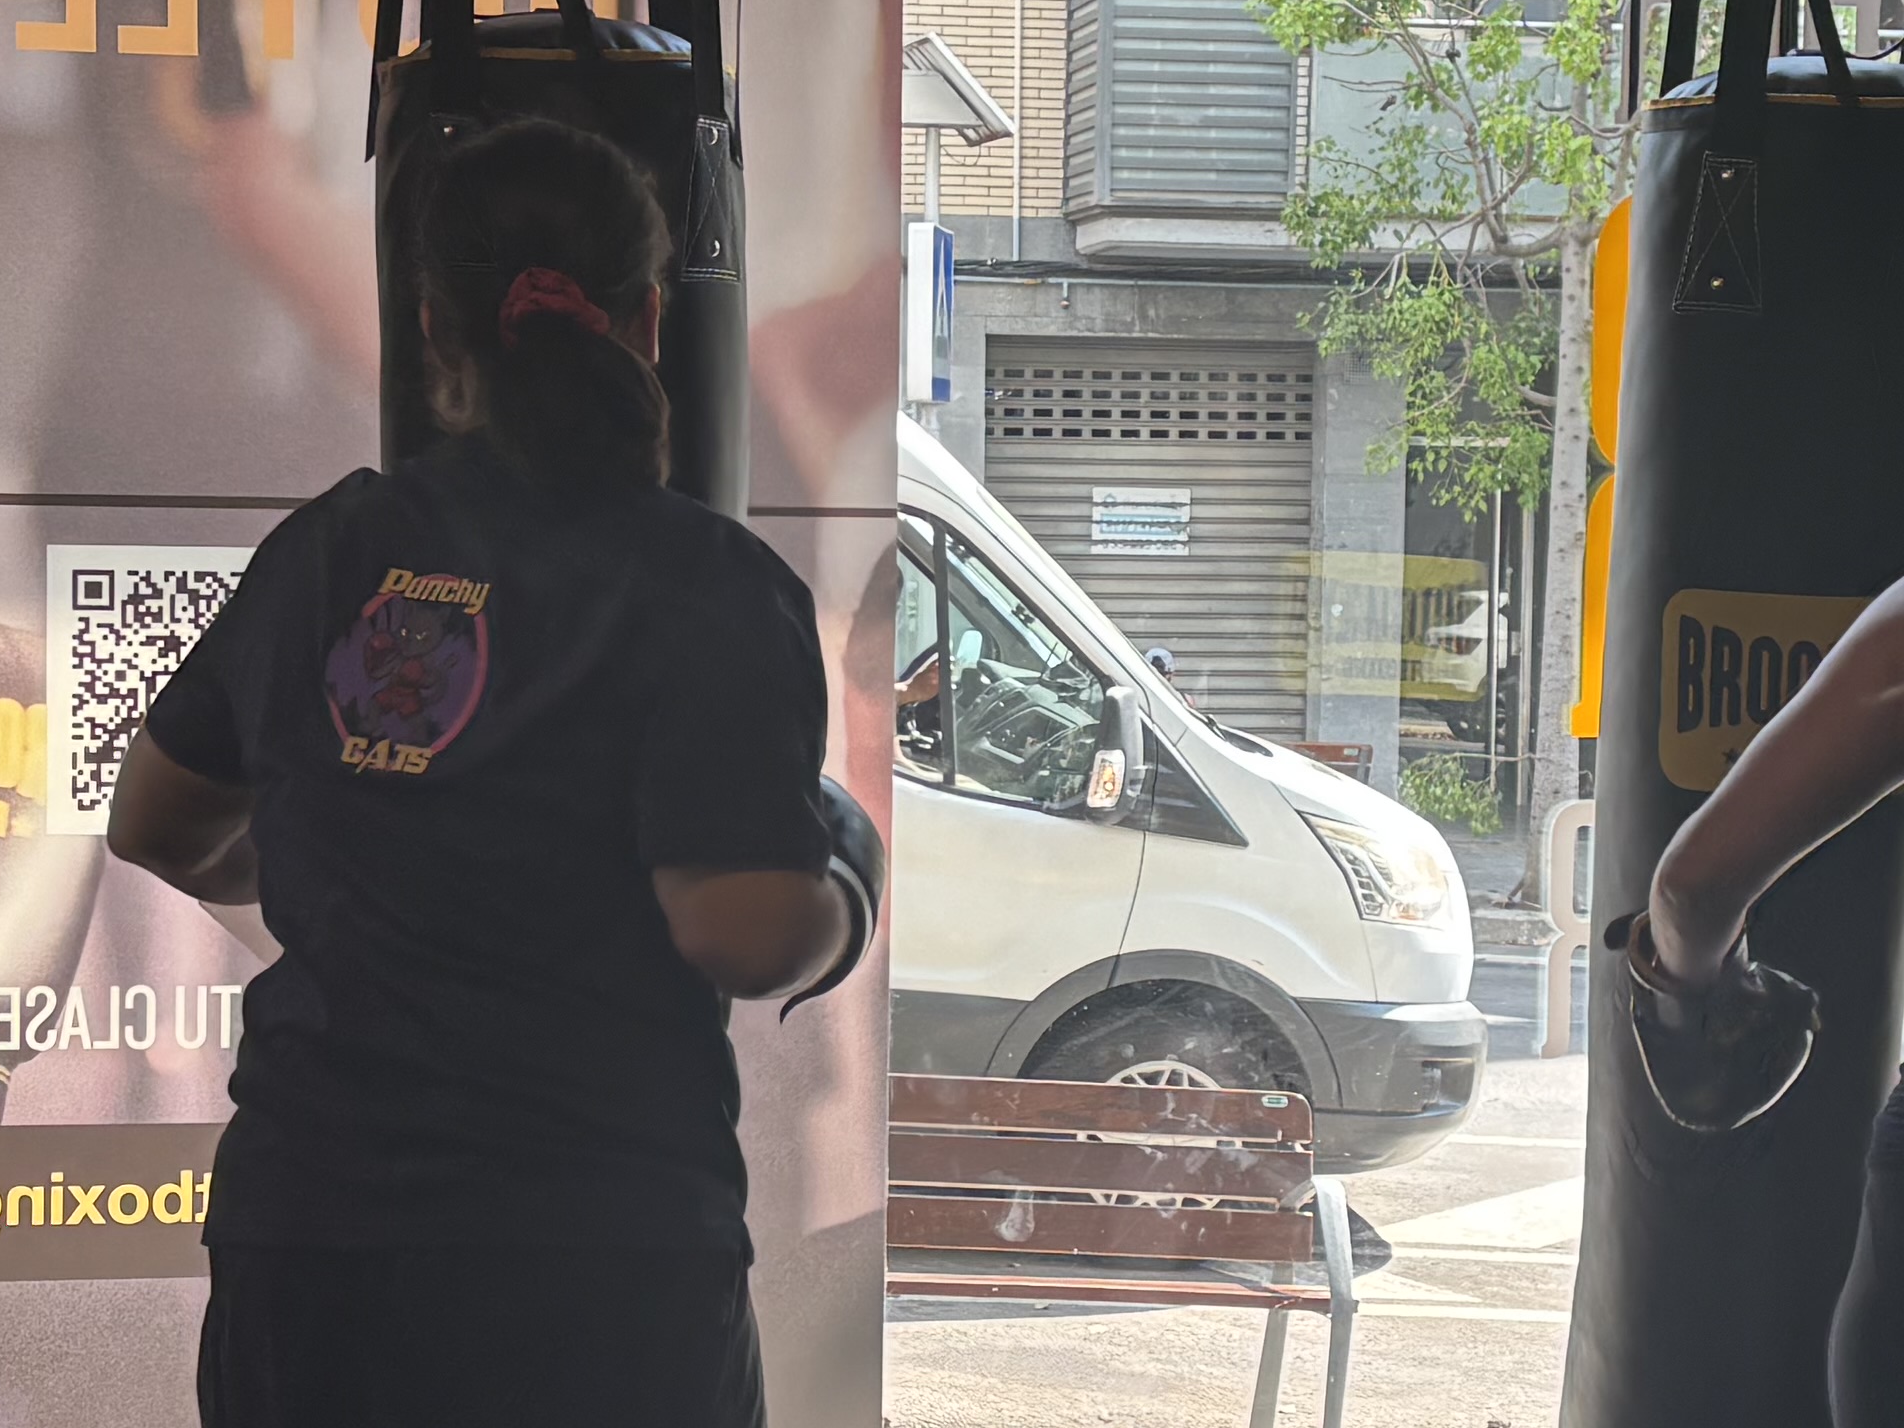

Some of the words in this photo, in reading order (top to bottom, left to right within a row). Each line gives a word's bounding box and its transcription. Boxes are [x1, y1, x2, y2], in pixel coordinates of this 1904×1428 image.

[378, 568, 490, 615] Punchy
[1677, 614, 1838, 734] BROO
[340, 735, 433, 774] CATS
